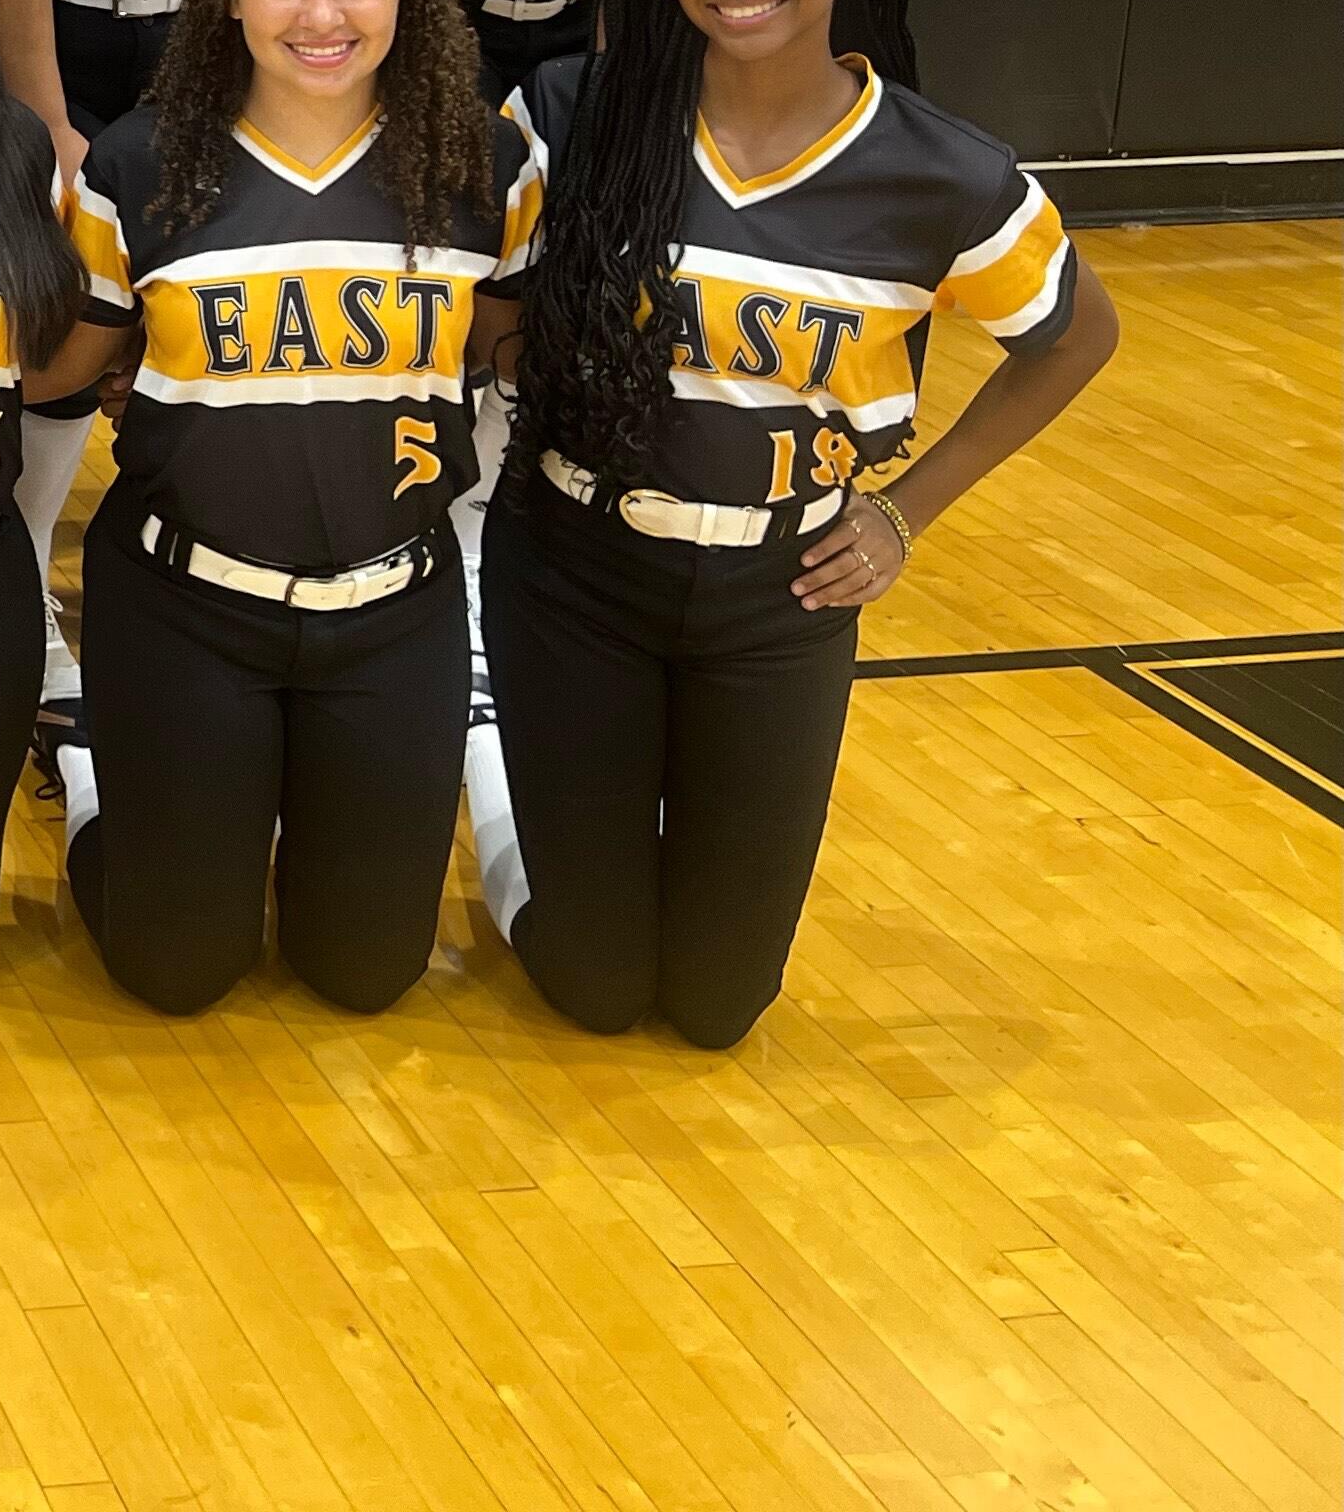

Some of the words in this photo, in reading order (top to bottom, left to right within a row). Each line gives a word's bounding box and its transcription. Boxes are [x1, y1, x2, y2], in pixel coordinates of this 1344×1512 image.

[190, 275, 454, 376] EAST
[673, 276, 867, 393] AST
[392, 415, 443, 501] 5
